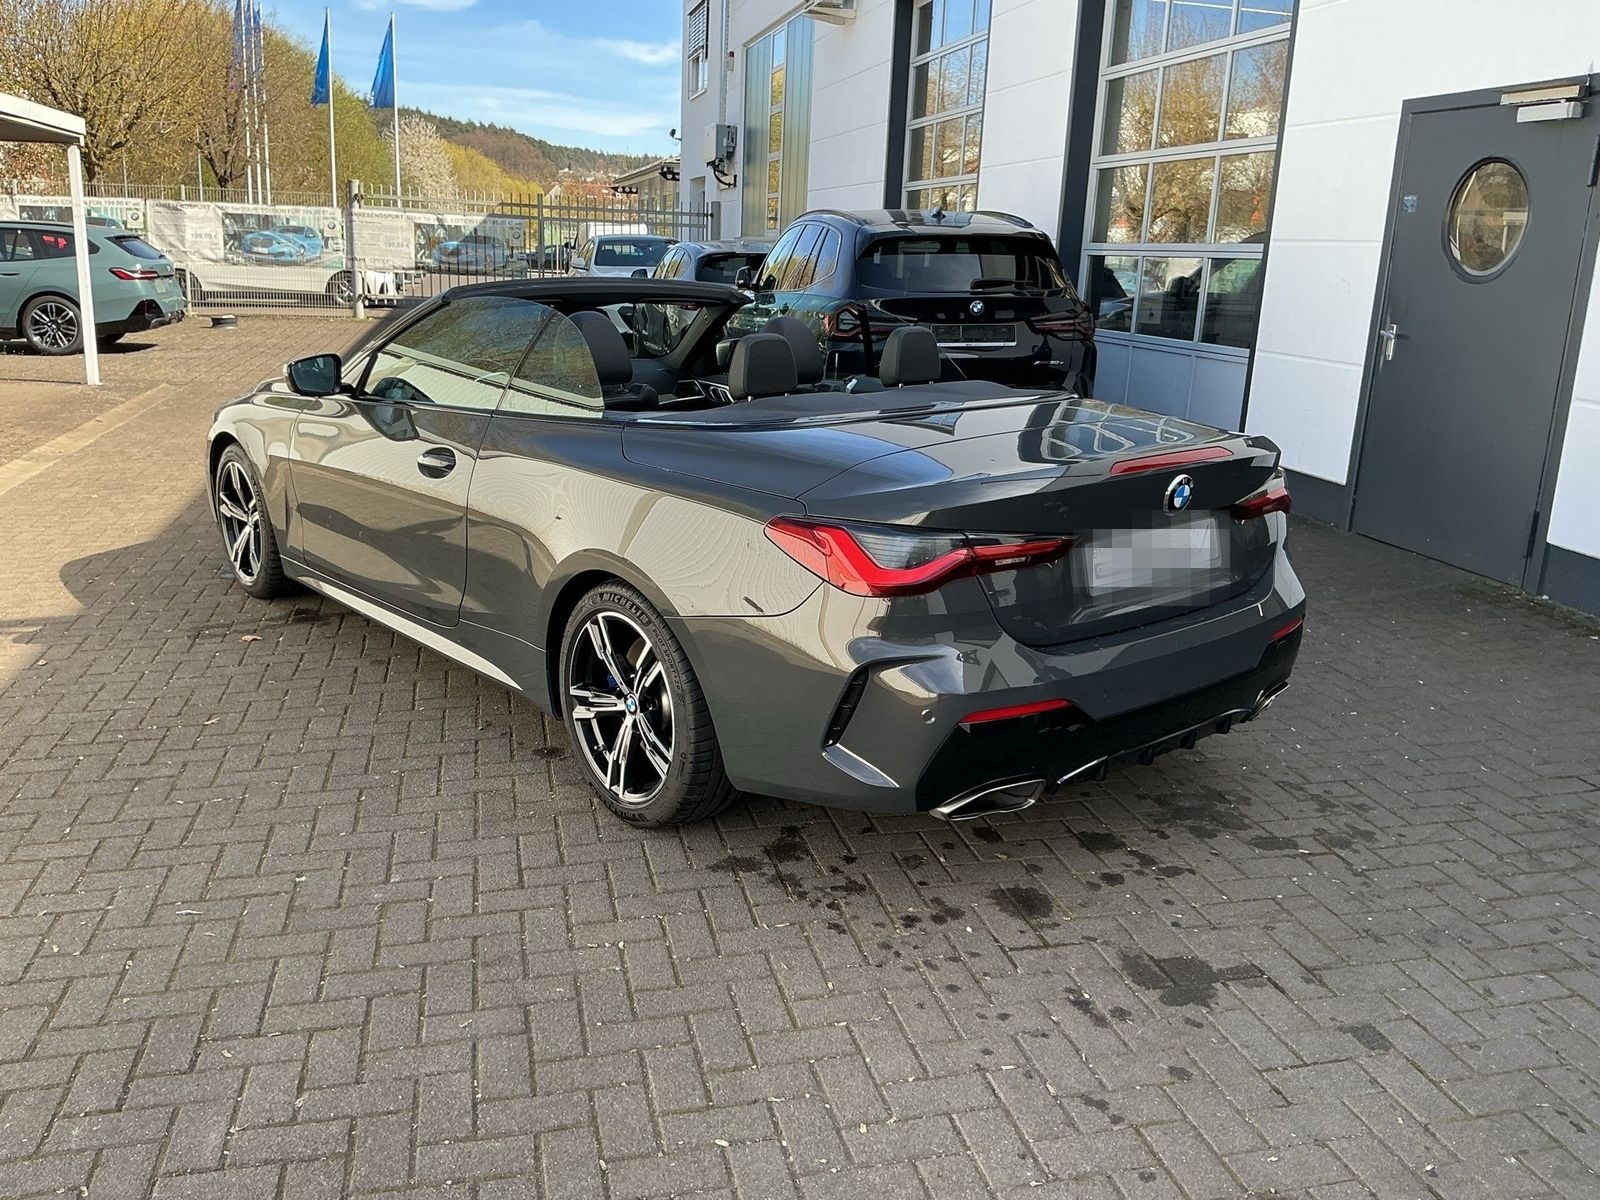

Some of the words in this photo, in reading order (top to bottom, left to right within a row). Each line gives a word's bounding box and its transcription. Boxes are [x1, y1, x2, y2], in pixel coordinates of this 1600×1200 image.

[602, 592, 649, 624] MICHELIN
[652, 628, 667, 648] PILOT
[663, 649, 677, 674] SPORT
